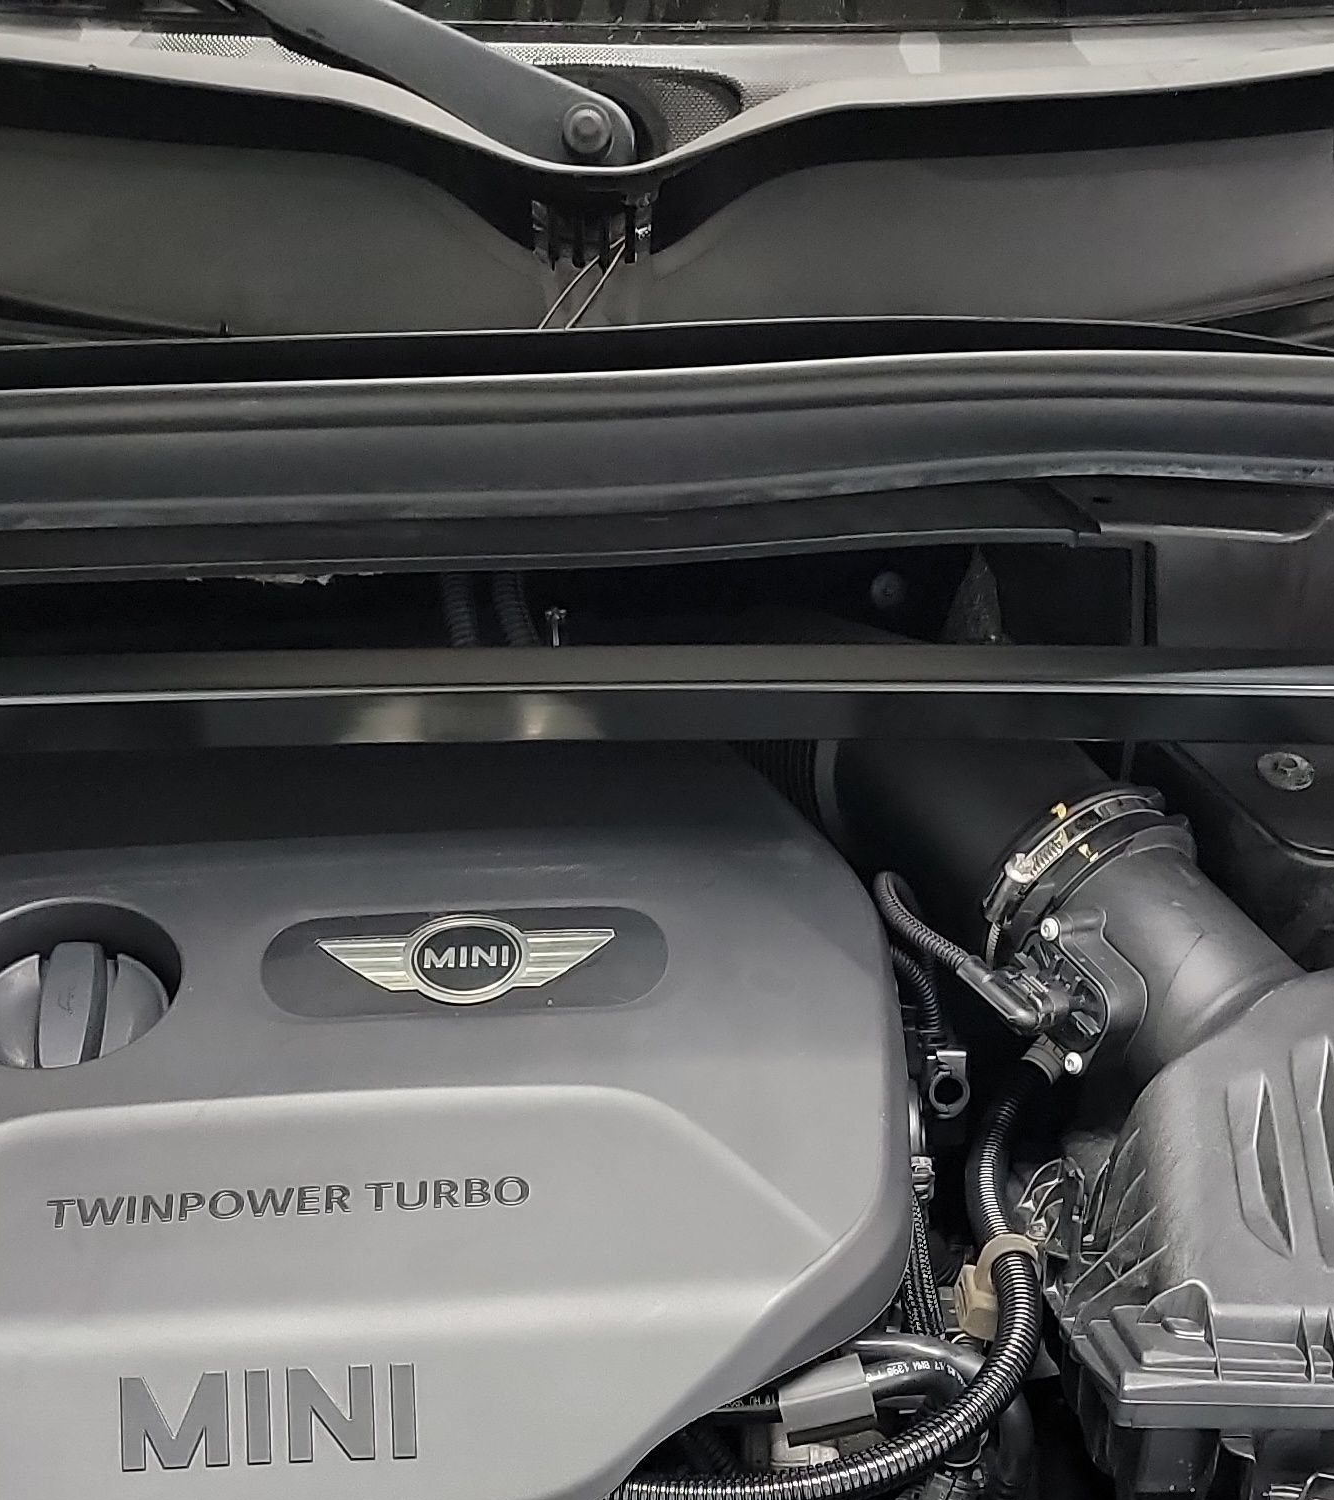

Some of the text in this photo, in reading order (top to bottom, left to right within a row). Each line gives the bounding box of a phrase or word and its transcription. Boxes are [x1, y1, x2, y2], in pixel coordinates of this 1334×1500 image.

[423, 944, 509, 969] MINI
[46, 1175, 531, 1228] TWINPOWER TURBO
[119, 1362, 417, 1472] MINI
